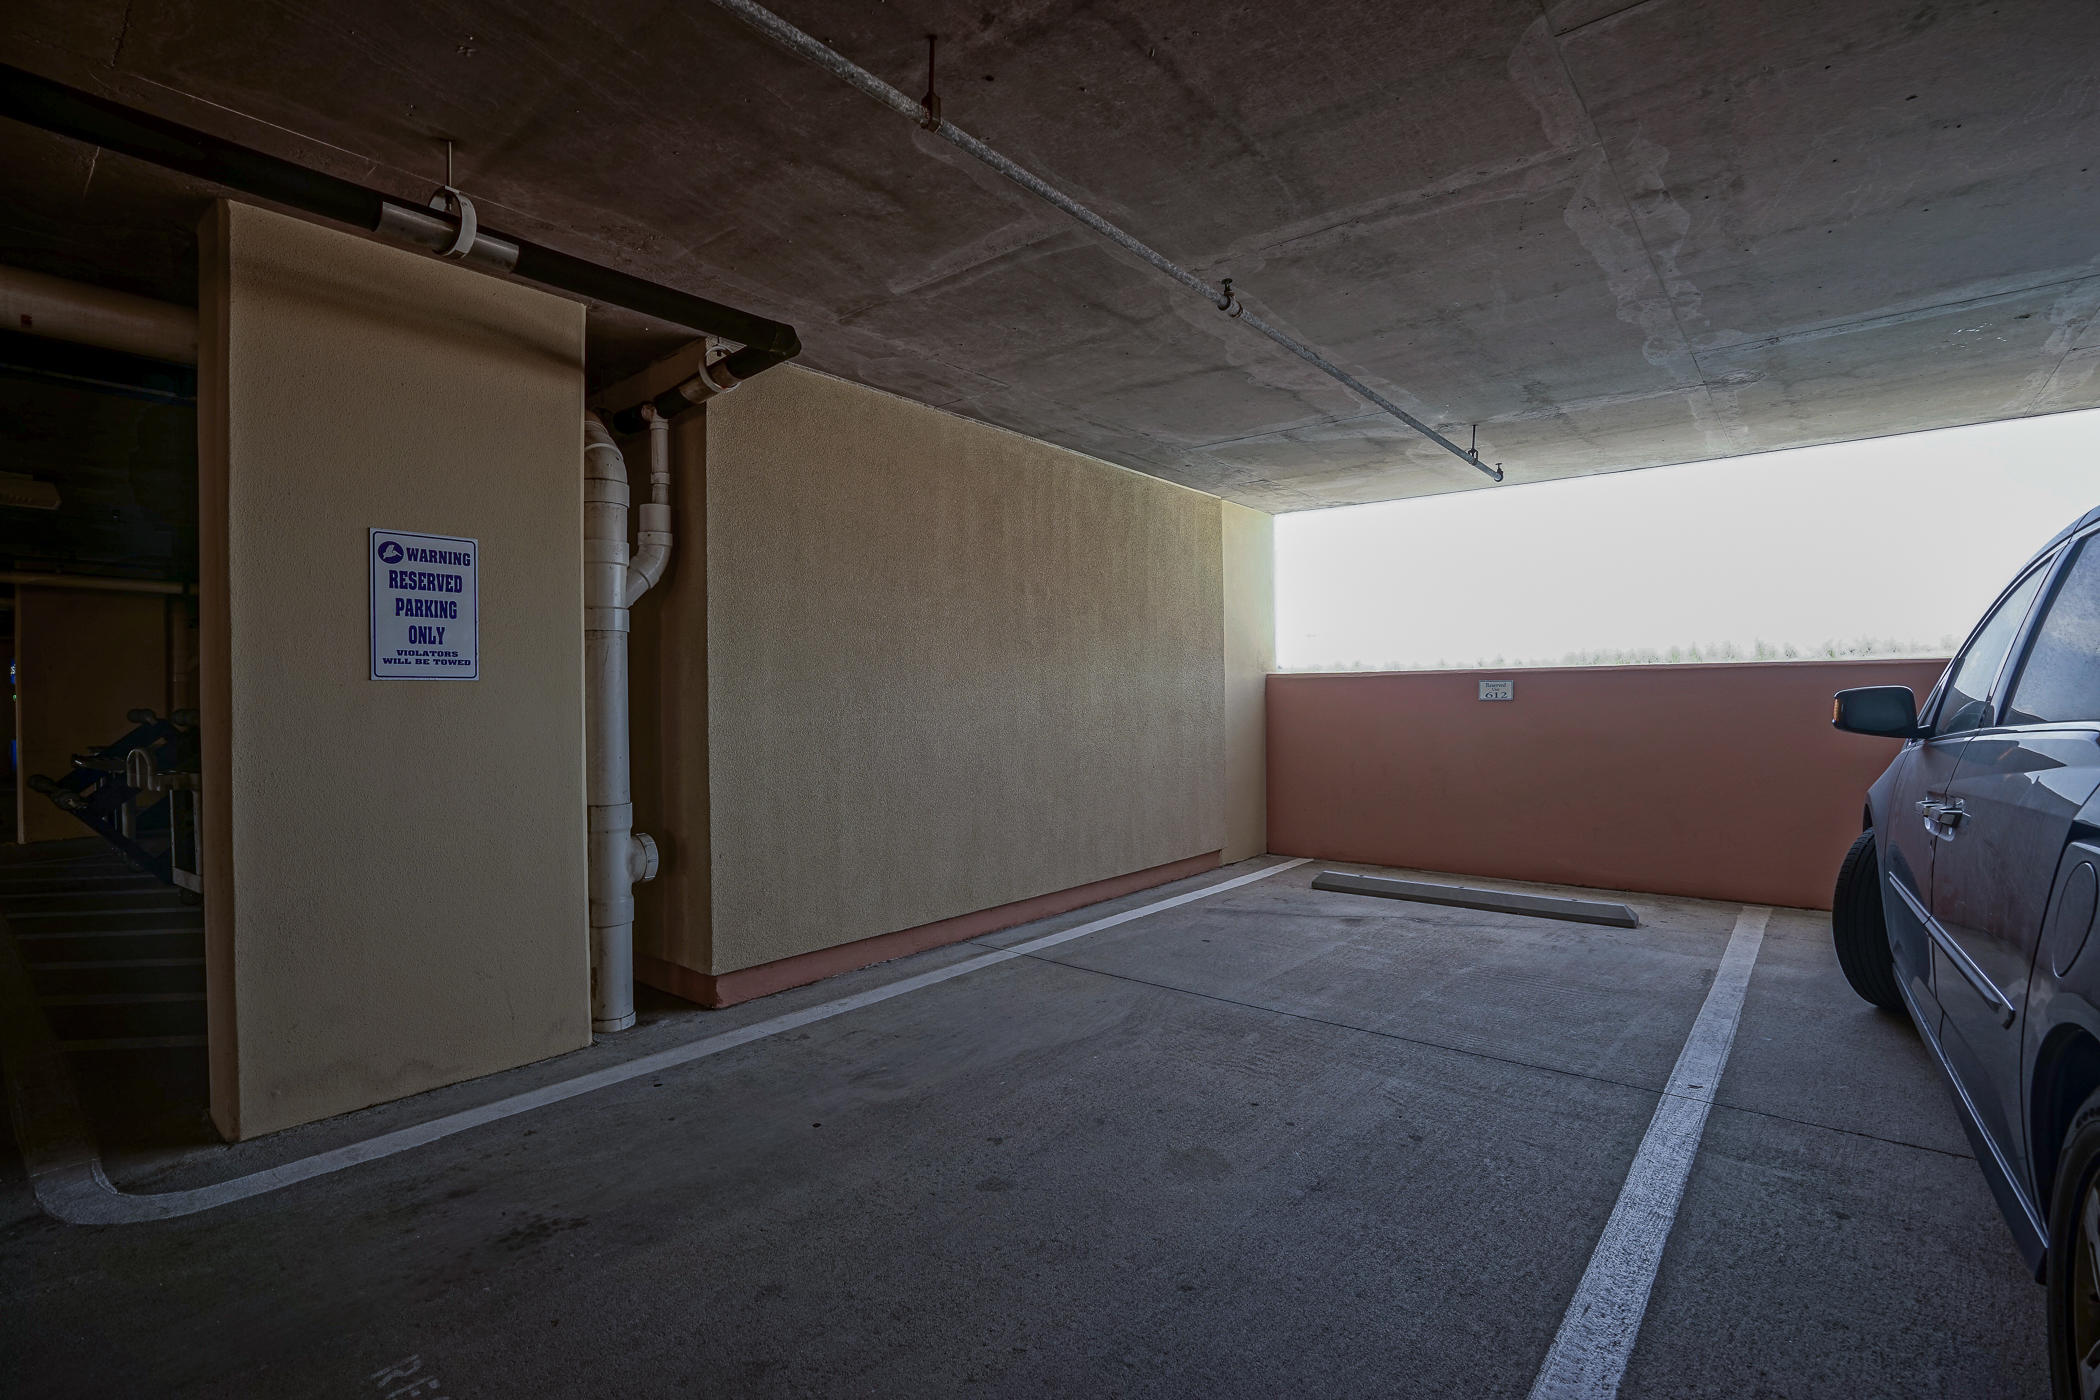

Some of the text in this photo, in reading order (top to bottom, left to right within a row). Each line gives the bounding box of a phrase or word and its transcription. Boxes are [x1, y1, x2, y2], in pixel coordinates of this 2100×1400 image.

[406, 547, 471, 567] WARNING
[388, 570, 463, 593] RESERVED
[395, 598, 457, 619] PARKING
[408, 625, 445, 645] ONLY
[382, 657, 411, 665] WILL
[433, 658, 471, 666] TOWED
[396, 649, 459, 658] VIOLATORS
